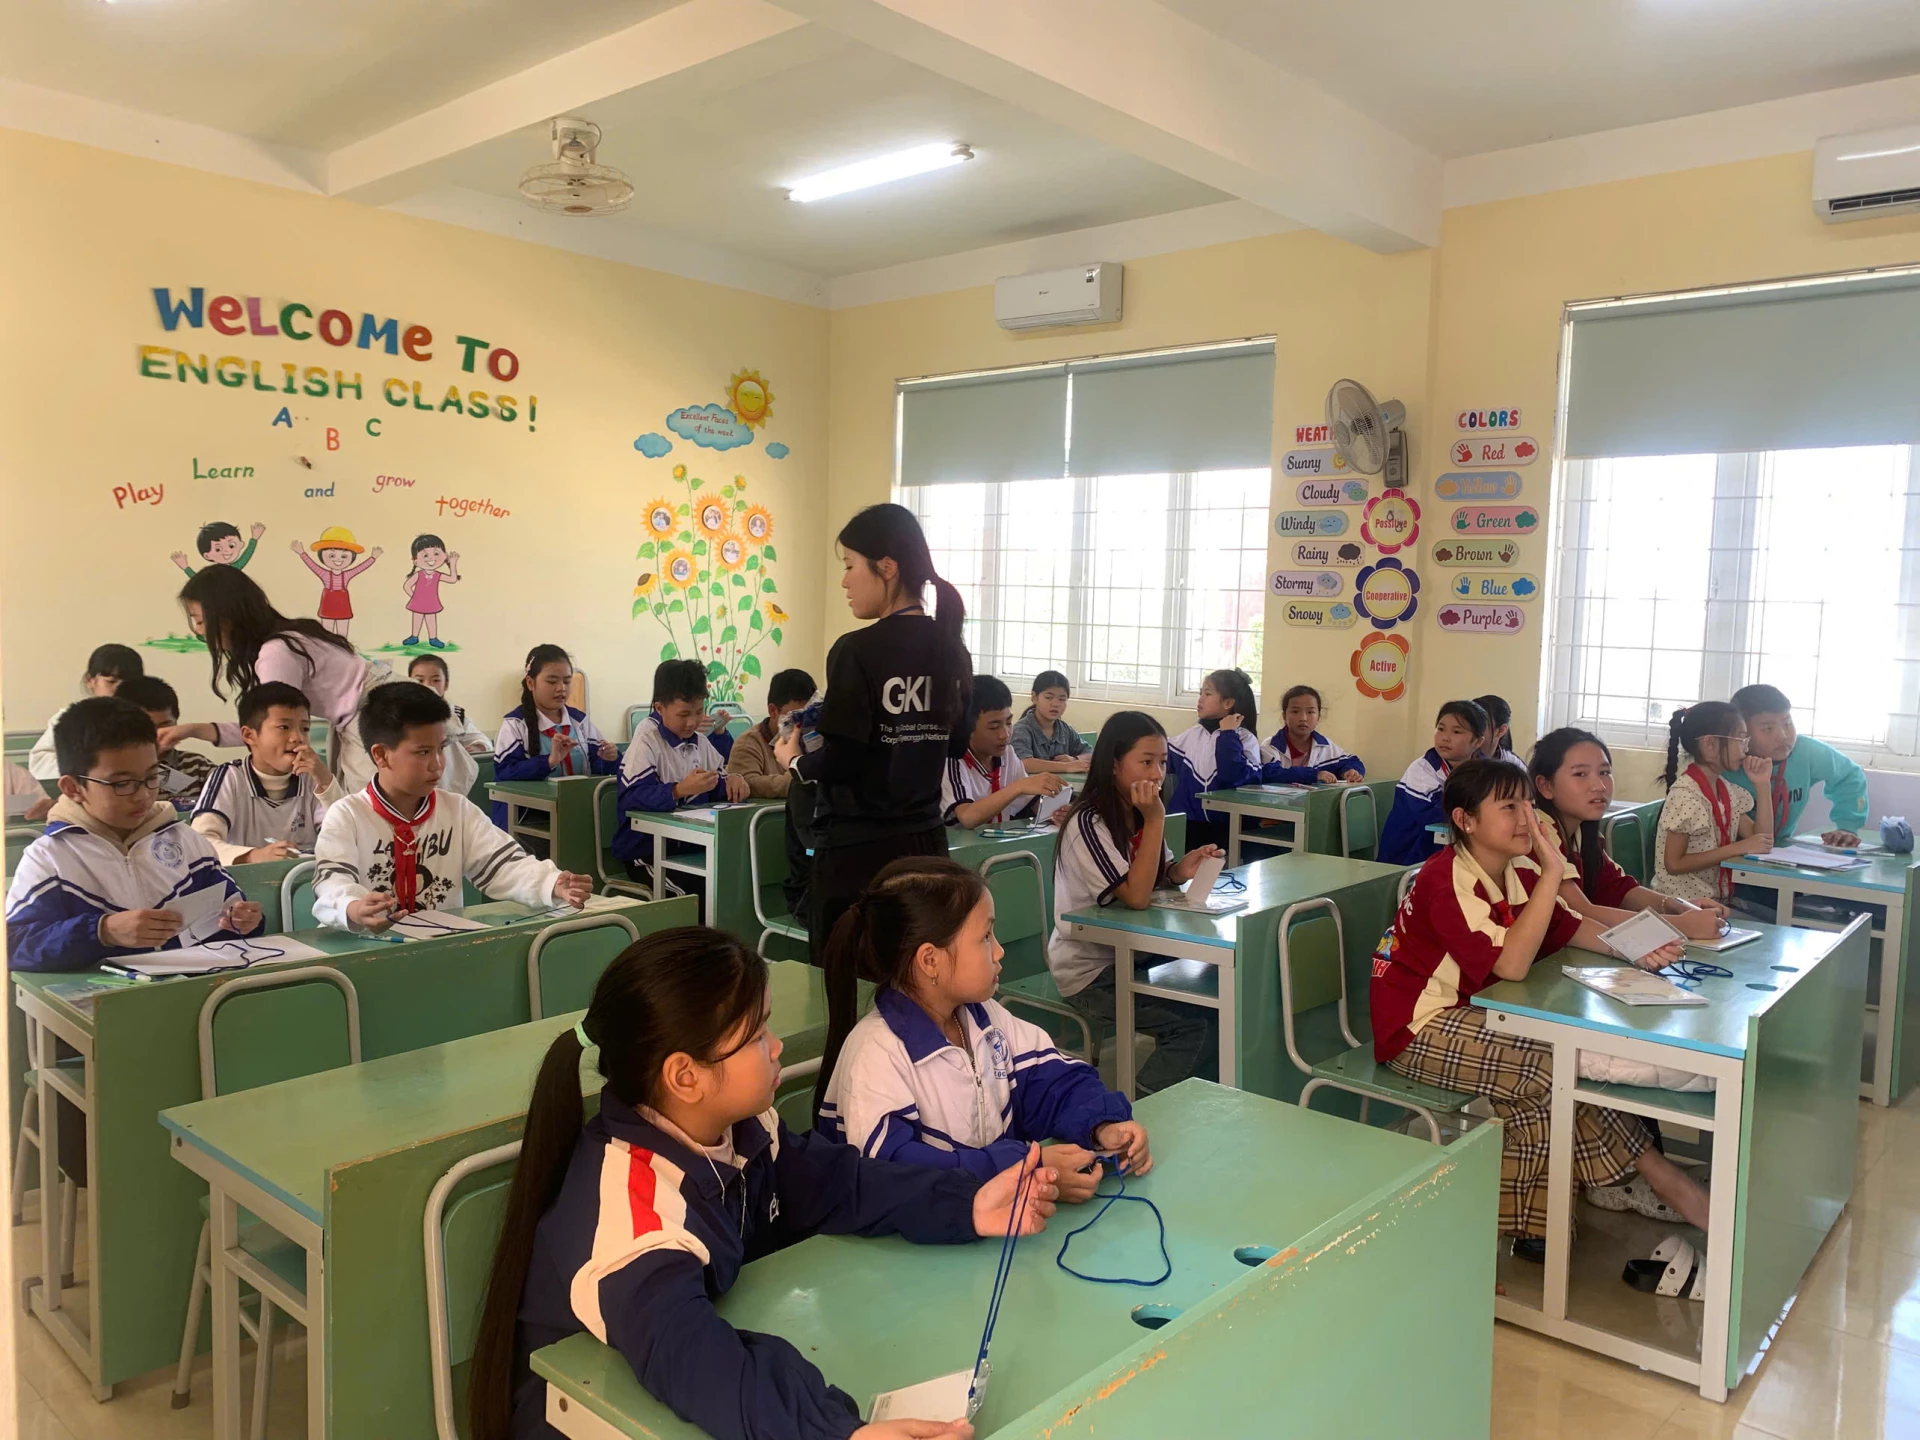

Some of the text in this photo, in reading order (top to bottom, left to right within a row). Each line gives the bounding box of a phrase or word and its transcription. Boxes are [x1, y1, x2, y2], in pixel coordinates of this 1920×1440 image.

[456, 335, 519, 382] TO
[140, 345, 538, 432] ENGLISH CLASS!
[681, 411, 729, 424] Excellent Faces
[1458, 409, 1519, 428] COLORS
[272, 406, 382, 451] A B C
[694, 424, 734, 437] of the week
[1482, 445, 1505, 460] Red
[1287, 455, 1321, 472] Sunny
[112, 457, 510, 519] Play Learn and grow together
[1302, 484, 1340, 503] Cloudy
[1460, 477, 1497, 494] Yellow
[1281, 514, 1316, 534] Windy
[1476, 512, 1511, 529] Green
[1298, 545, 1328, 564] Rainy
[1455, 545, 1493, 561] Brown
[1275, 574, 1314, 594] Stormy
[1481, 579, 1508, 596] Blue
[1366, 590, 1408, 602] Cooperative
[1288, 605, 1323, 624] Snowy
[1463, 610, 1503, 629] Purple
[1369, 659, 1397, 673] Active
[879, 723, 893, 732] The
